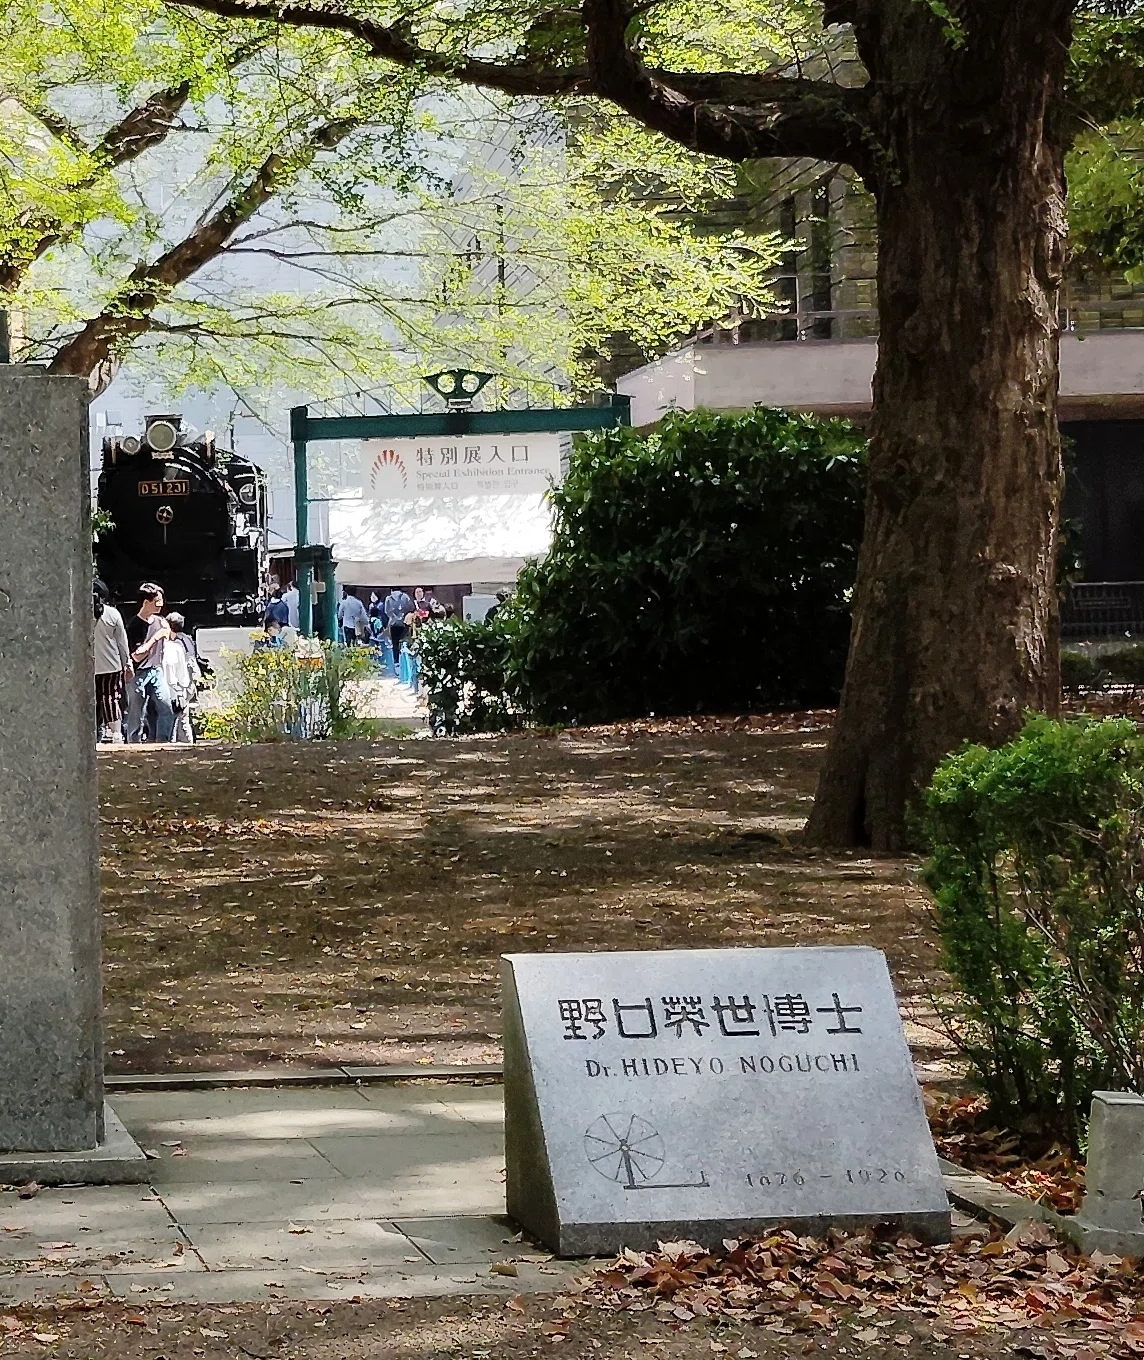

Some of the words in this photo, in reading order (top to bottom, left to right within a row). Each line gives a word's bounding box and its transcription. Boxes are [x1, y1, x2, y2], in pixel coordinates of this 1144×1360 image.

[416, 445, 529, 466] 特別展入口
[416, 467, 450, 481] Special
[454, 466, 504, 477] Exhibition
[507, 465, 550, 476] Entrance
[739, 1052, 860, 1075] NOGUCHI
